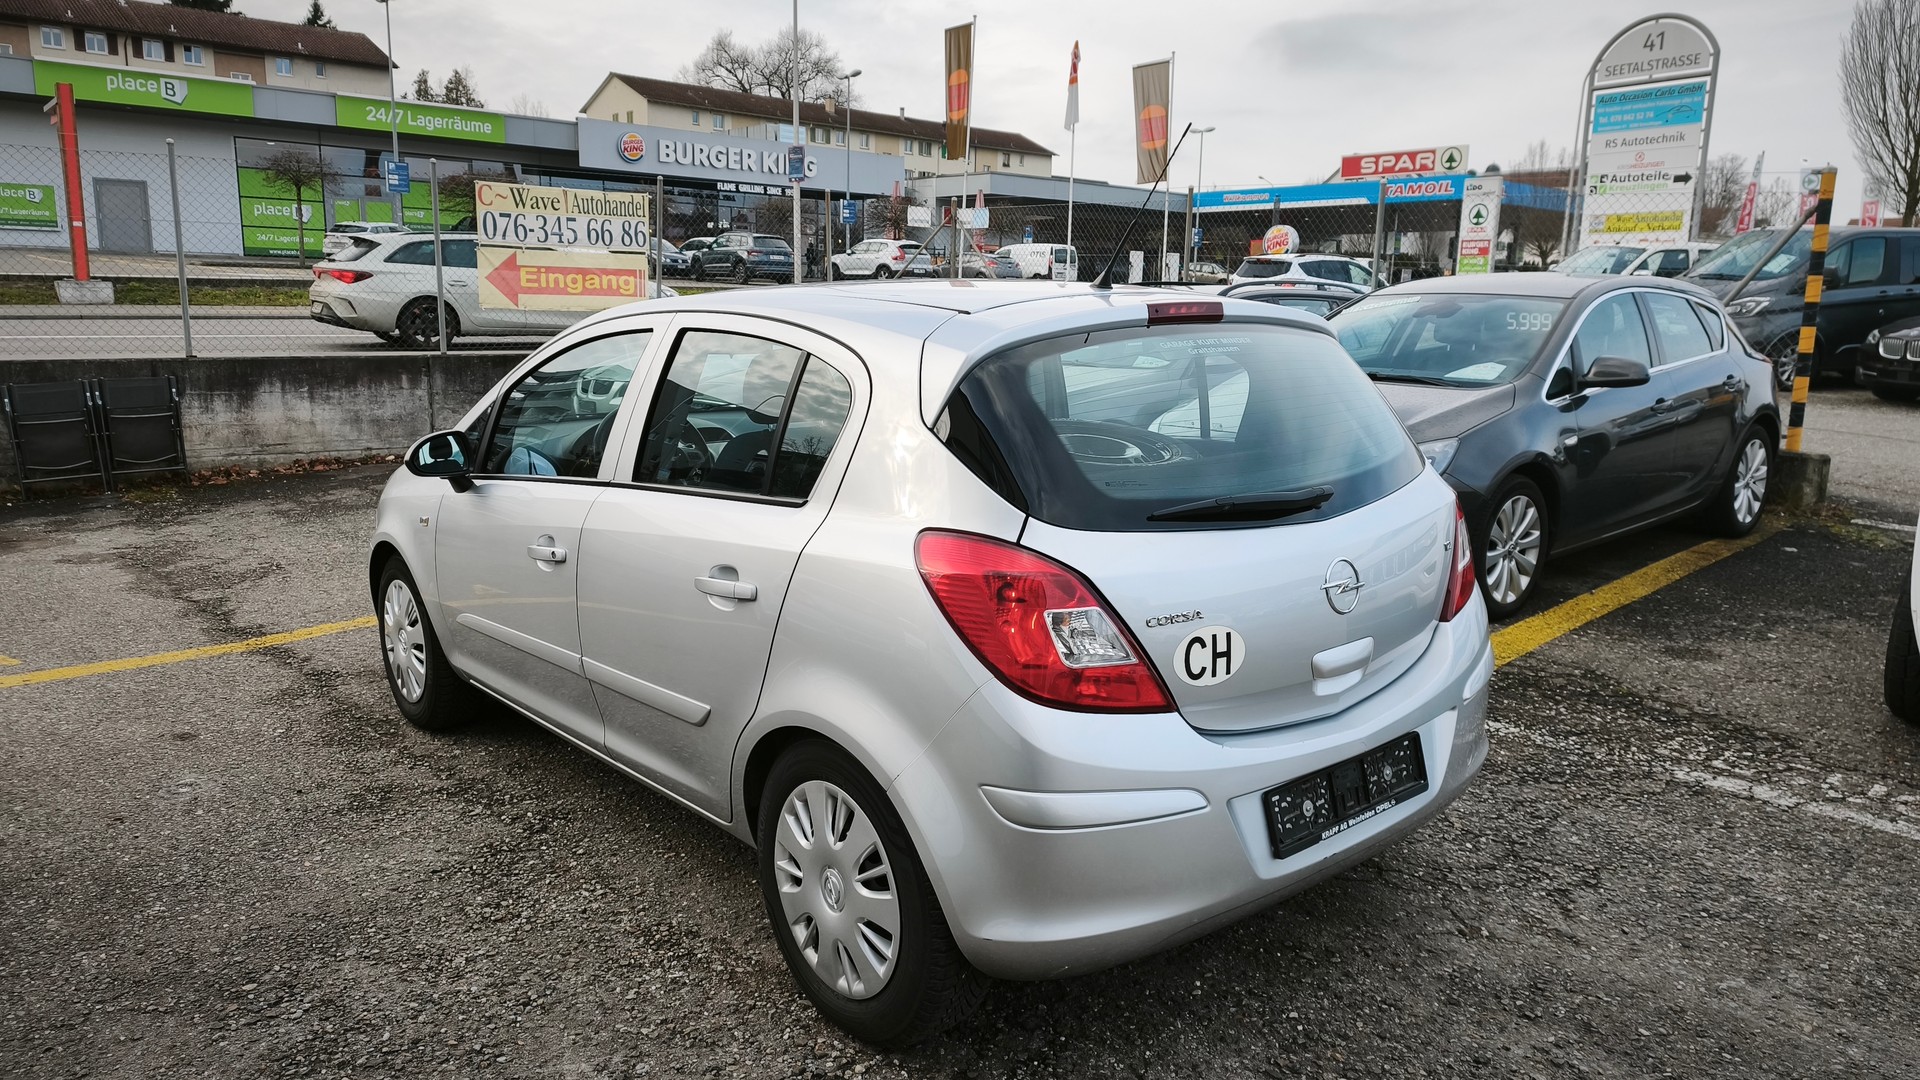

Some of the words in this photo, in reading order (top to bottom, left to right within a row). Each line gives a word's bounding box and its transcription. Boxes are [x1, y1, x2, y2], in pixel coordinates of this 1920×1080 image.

[1642, 30, 1666, 52] 41
[1604, 52, 1702, 77] SEETALSTRASSE
[106, 73, 158, 93] place
[1599, 95, 1618, 104] Auto
[1619, 91, 1653, 102] Occasion
[1654, 87, 1675, 98] Carlo
[1677, 84, 1704, 95] GmbH
[365, 106, 403, 124] 24/7
[407, 110, 493, 134] Lagerräume
[623, 144, 644, 153] KING
[1605, 138, 1618, 149] RS
[1620, 131, 1686, 148] Autotechnik
[658, 139, 757, 172] BURGER
[762, 151, 818, 178] KIG
[1360, 151, 1436, 175] SPAR
[1610, 170, 1670, 184] Autoteile
[716, 181, 736, 192] FLAME
[739, 183, 764, 194] GRILLING
[766, 186, 782, 196] SINCE
[1384, 180, 1455, 198] TAMOIL
[1608, 181, 1669, 193] Kreuzlingen
[253, 202, 291, 217] place
[571, 191, 648, 218] Autohandel
[482, 210, 578, 245] 076-345
[586, 217, 614, 247] 66
[621, 220, 647, 248] 86
[1606, 223, 1638, 233] Ankauf
[1646, 220, 1683, 232] Verkauf
[1266, 231, 1289, 244] BURGER
[1266, 238, 1289, 251] KING
[1029, 250, 1047, 258] OTIS
[519, 266, 636, 296] Eingang
[1506, 312, 1552, 331] 5.999
[1160, 338, 1197, 349] GARAGE
[1197, 337, 1222, 346] KURT
[1221, 336, 1252, 345] MINDER
[1145, 609, 1205, 629] CORSA
[1184, 631, 1232, 681] CH
[1321, 824, 1340, 840] KRAPF
[1339, 822, 1348, 832] AG
[1348, 809, 1376, 828] Weinfelden
[1375, 801, 1393, 814] OPEL
